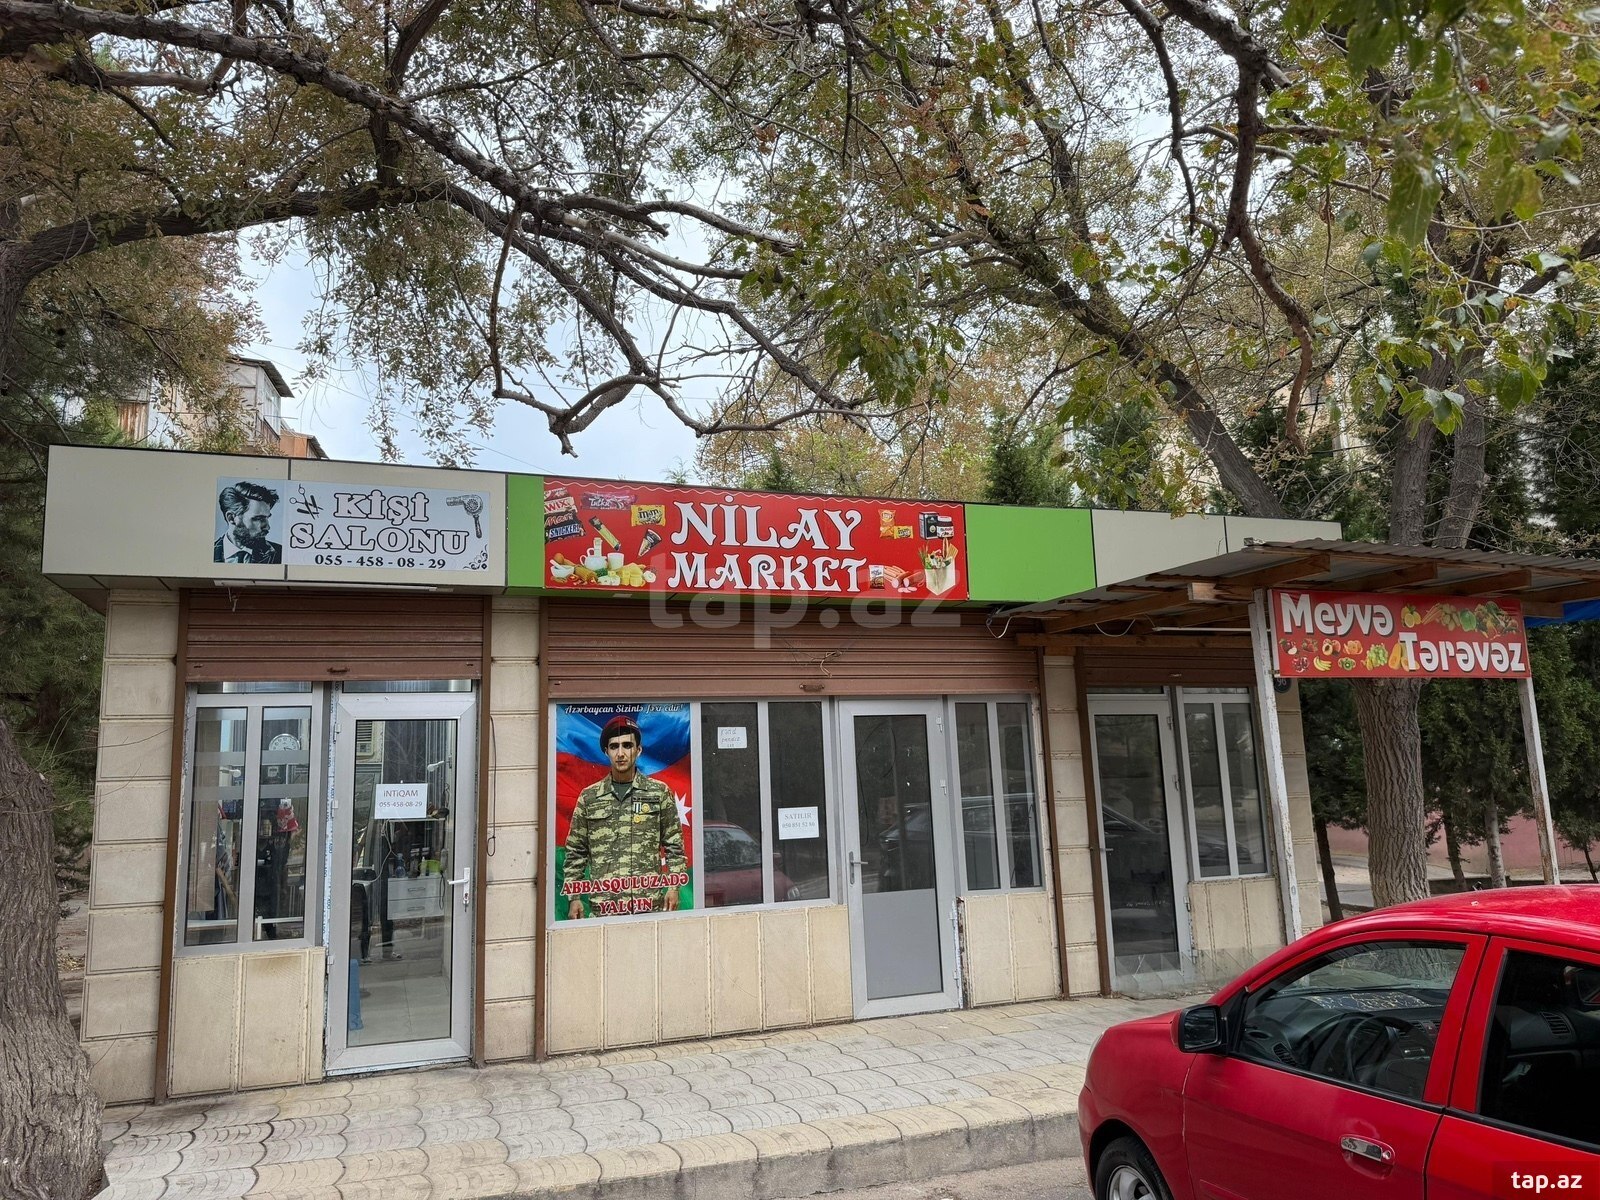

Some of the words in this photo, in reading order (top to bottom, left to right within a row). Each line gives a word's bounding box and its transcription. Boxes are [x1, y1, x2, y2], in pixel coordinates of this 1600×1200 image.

[334, 489, 429, 525] KİŞİ
[670, 495, 862, 551] NİLAY
[290, 522, 469, 555] SALONU
[314, 554, 343, 565] 055
[356, 555, 384, 567] 458
[397, 557, 415, 568] 08
[428, 558, 446, 569] 29
[667, 551, 867, 592] MARKET
[1279, 592, 1394, 637] Meyvə
[1399, 631, 1526, 673] Tərəvəz
[565, 704, 614, 716] Azərbaycan
[784, 812, 812, 820] SATILIR
[561, 872, 689, 895] ABBASQULUZADƏ
